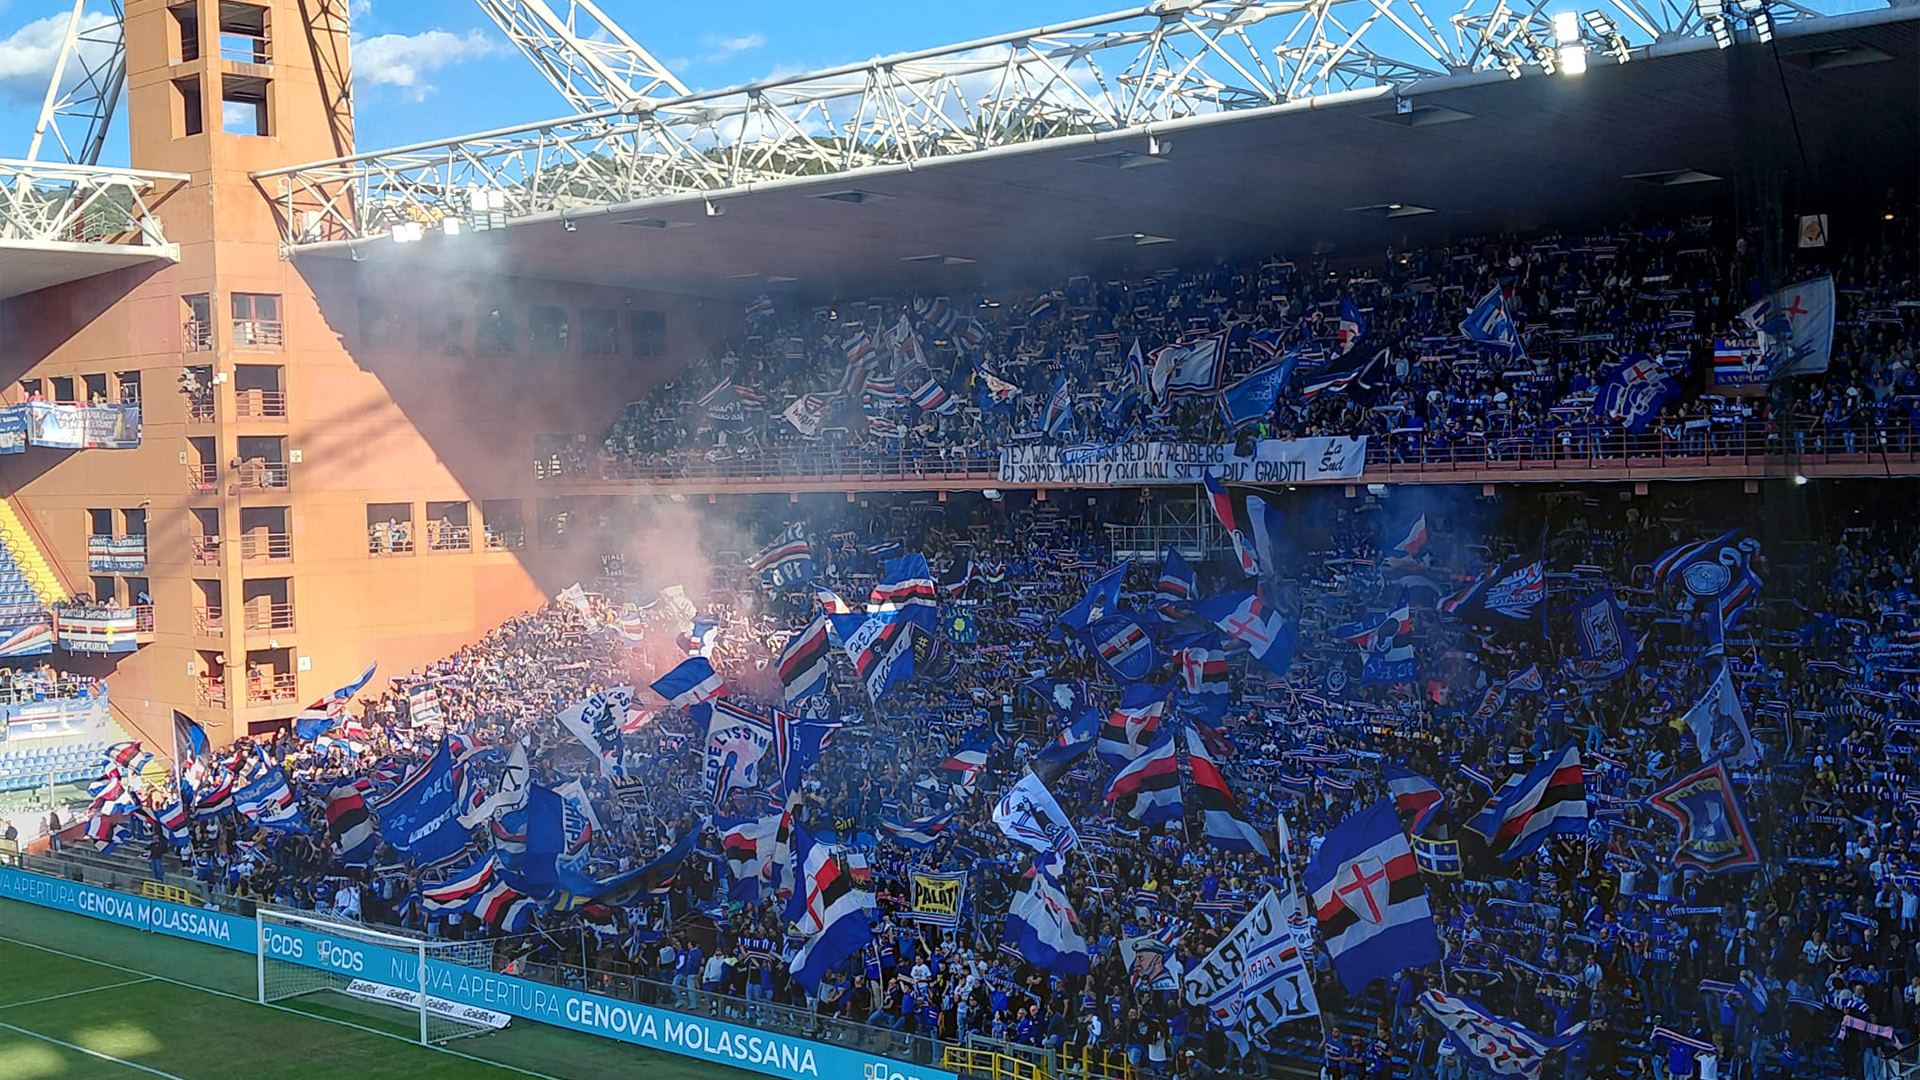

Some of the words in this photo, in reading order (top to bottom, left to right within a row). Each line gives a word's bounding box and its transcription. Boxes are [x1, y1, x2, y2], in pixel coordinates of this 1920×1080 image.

[1324, 439, 1342, 456] La
[1003, 465, 1015, 483] CI
[1020, 464, 1055, 483] SIAMO
[1255, 461, 1306, 481] GRADITI
[1319, 457, 1344, 472] Sud
[13, 877, 76, 907] APERTURA
[78, 888, 134, 921] GENOVA
[138, 904, 230, 941] MOLASSANA
[269, 933, 303, 957] CDS
[330, 945, 364, 972] CDS
[386, 989, 417, 1003] GoldBet
[425, 998, 455, 1013] GoldBet
[390, 957, 453, 990] NUOVA
[458, 973, 560, 1018] APERTURA
[566, 997, 658, 1041] GENOVA
[664, 1018, 818, 1077] MOLASSANA
[463, 1008, 496, 1024] GoldBet
